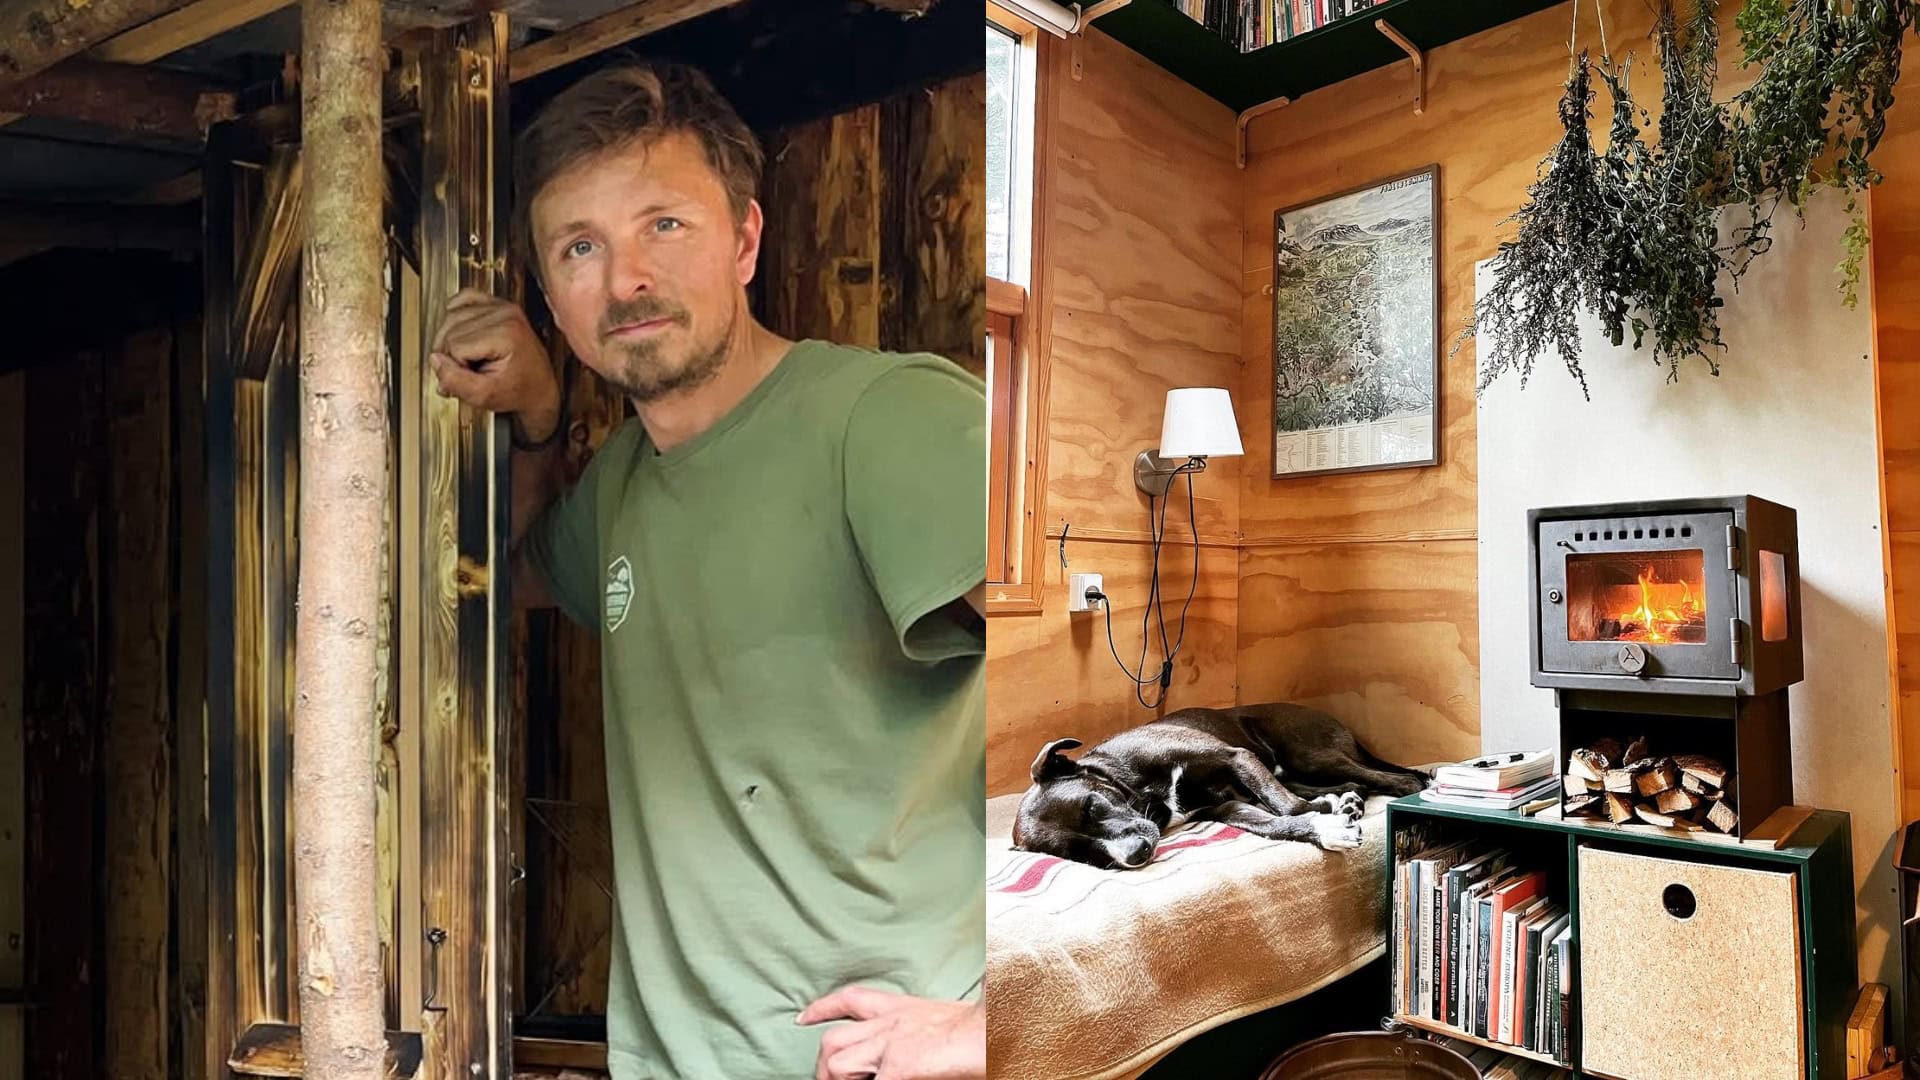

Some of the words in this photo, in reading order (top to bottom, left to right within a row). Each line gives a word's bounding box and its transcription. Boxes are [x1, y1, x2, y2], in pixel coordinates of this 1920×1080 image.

[1449, 928, 1459, 960] spiselige
[1504, 920, 1513, 958] FUGLENE
[1449, 961, 1458, 1002] permahave
[1503, 963, 1511, 995] EUROPA
